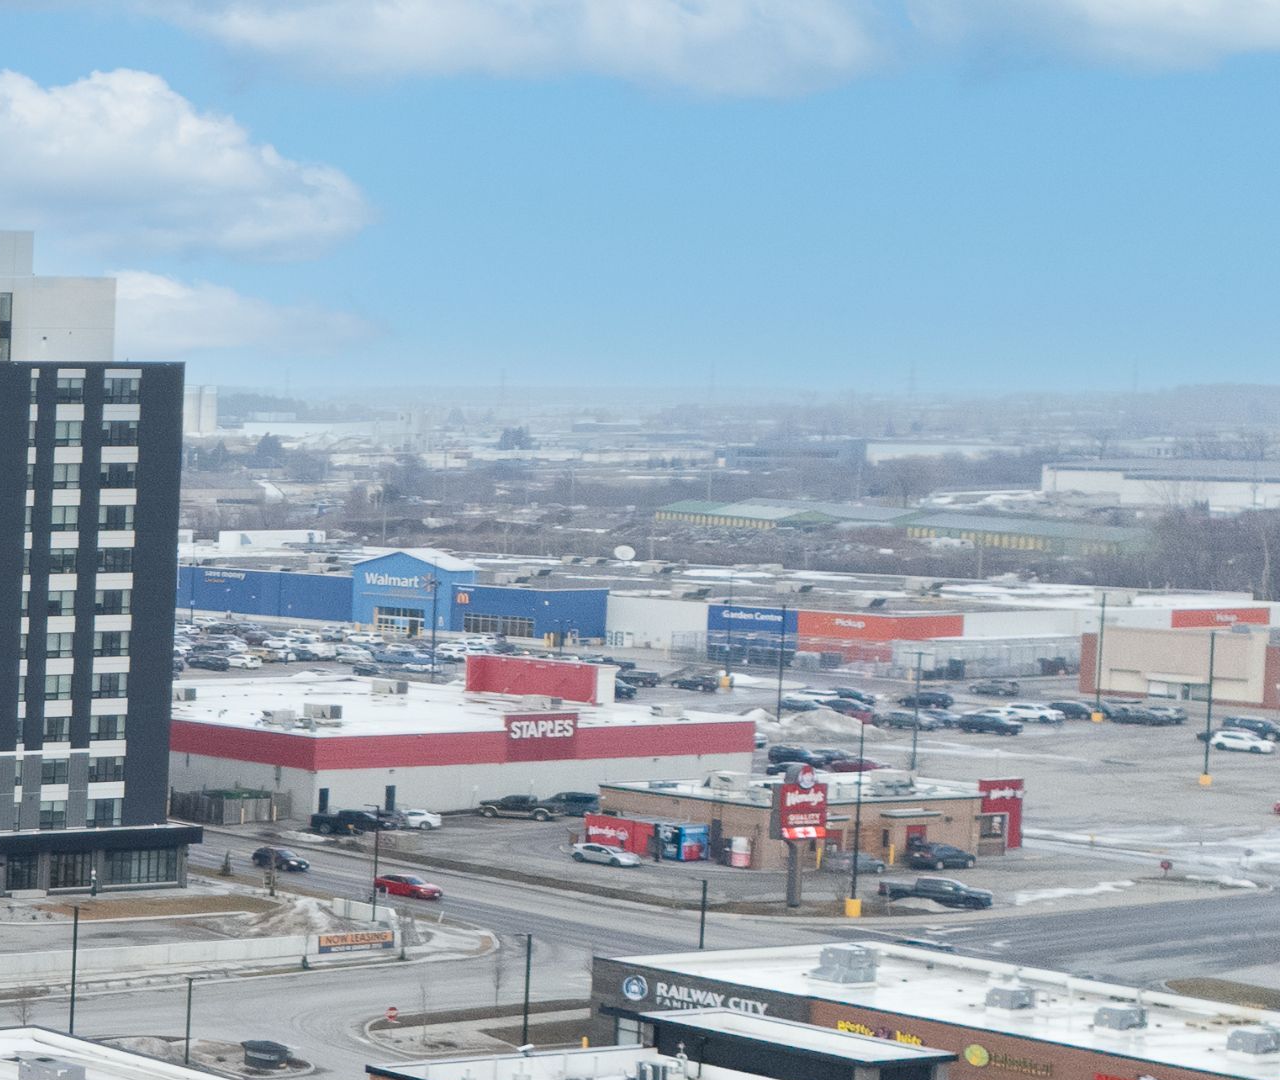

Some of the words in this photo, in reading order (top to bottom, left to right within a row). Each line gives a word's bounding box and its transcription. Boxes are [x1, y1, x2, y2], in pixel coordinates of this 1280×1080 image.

[364, 572, 419, 588] Walmart
[722, 610, 753, 619] Garden
[755, 612, 783, 621] Centre
[510, 720, 574, 739] STAPLES
[656, 982, 725, 1007] RAILWAY
[728, 997, 768, 1016] CITY
